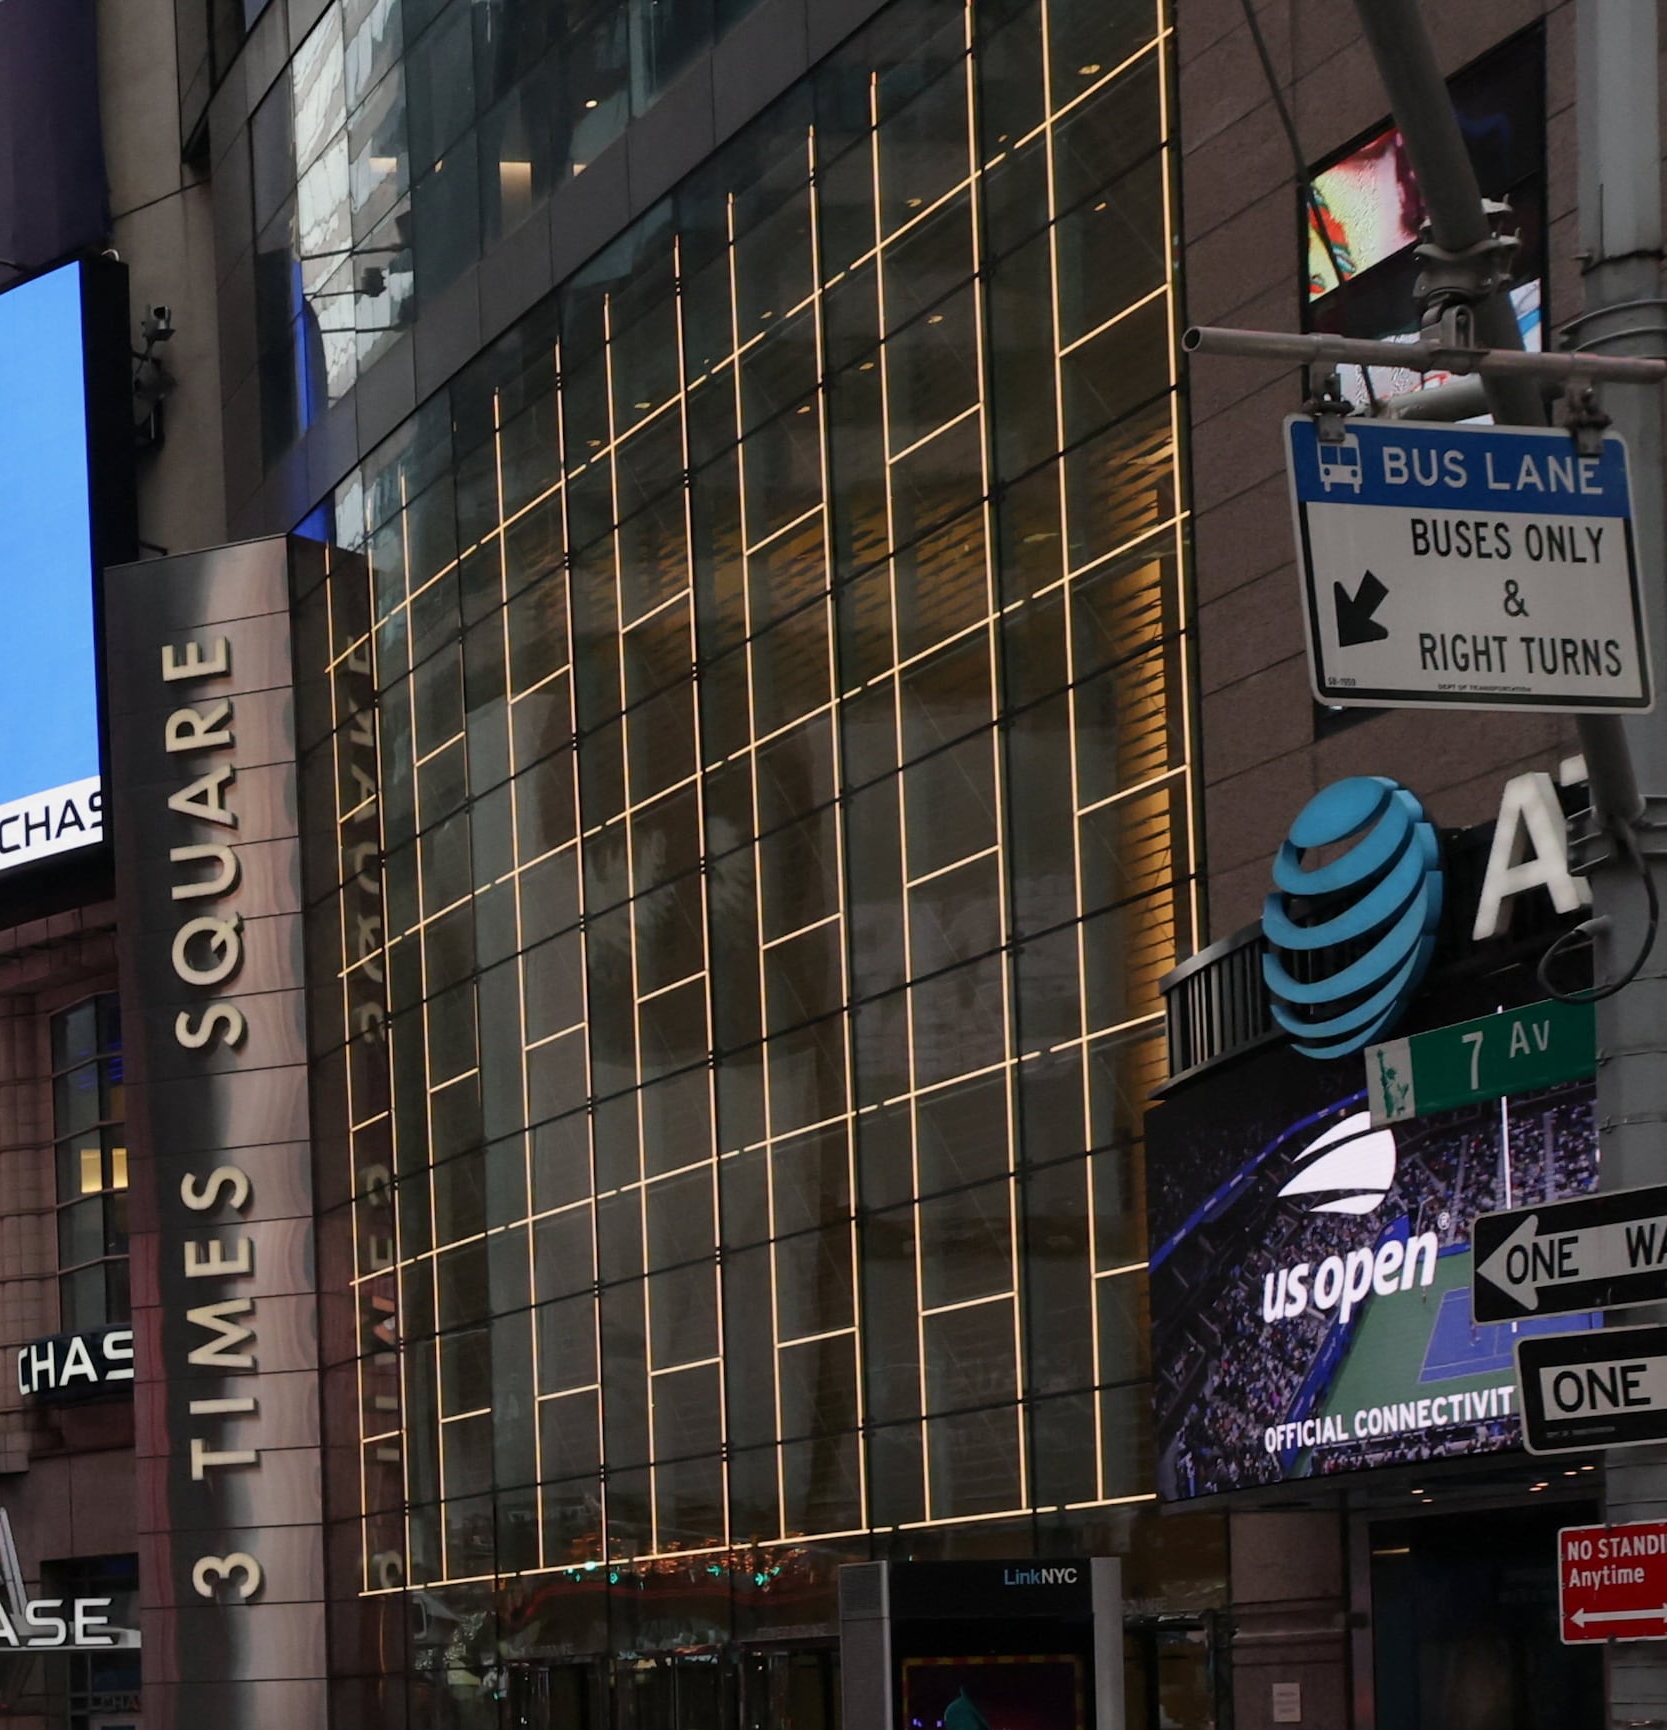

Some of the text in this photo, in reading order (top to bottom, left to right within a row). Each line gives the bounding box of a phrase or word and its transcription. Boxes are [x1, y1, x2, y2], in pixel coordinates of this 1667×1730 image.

[1382, 446, 1604, 494] BUS LANE
[1411, 518, 1603, 563] BUSES ONLY
[1504, 579, 1529, 617] &
[1419, 633, 1622, 677] RIGHT TURNS
[1461, 1031, 1483, 1090] 7
[162, 636, 262, 1600] 3 TIMES SQUARE
[1263, 1231, 1438, 1324] us open
[1507, 1235, 1579, 1286] ONE
[1552, 1364, 1652, 1413] ONE
[1265, 1385, 1517, 1454] OFFICIAL CONNECTIVIT
[1567, 1540, 1592, 1561] NO
[1004, 1568, 1078, 1586] LinkNYC
[1569, 1565, 1644, 1591] Anytime
